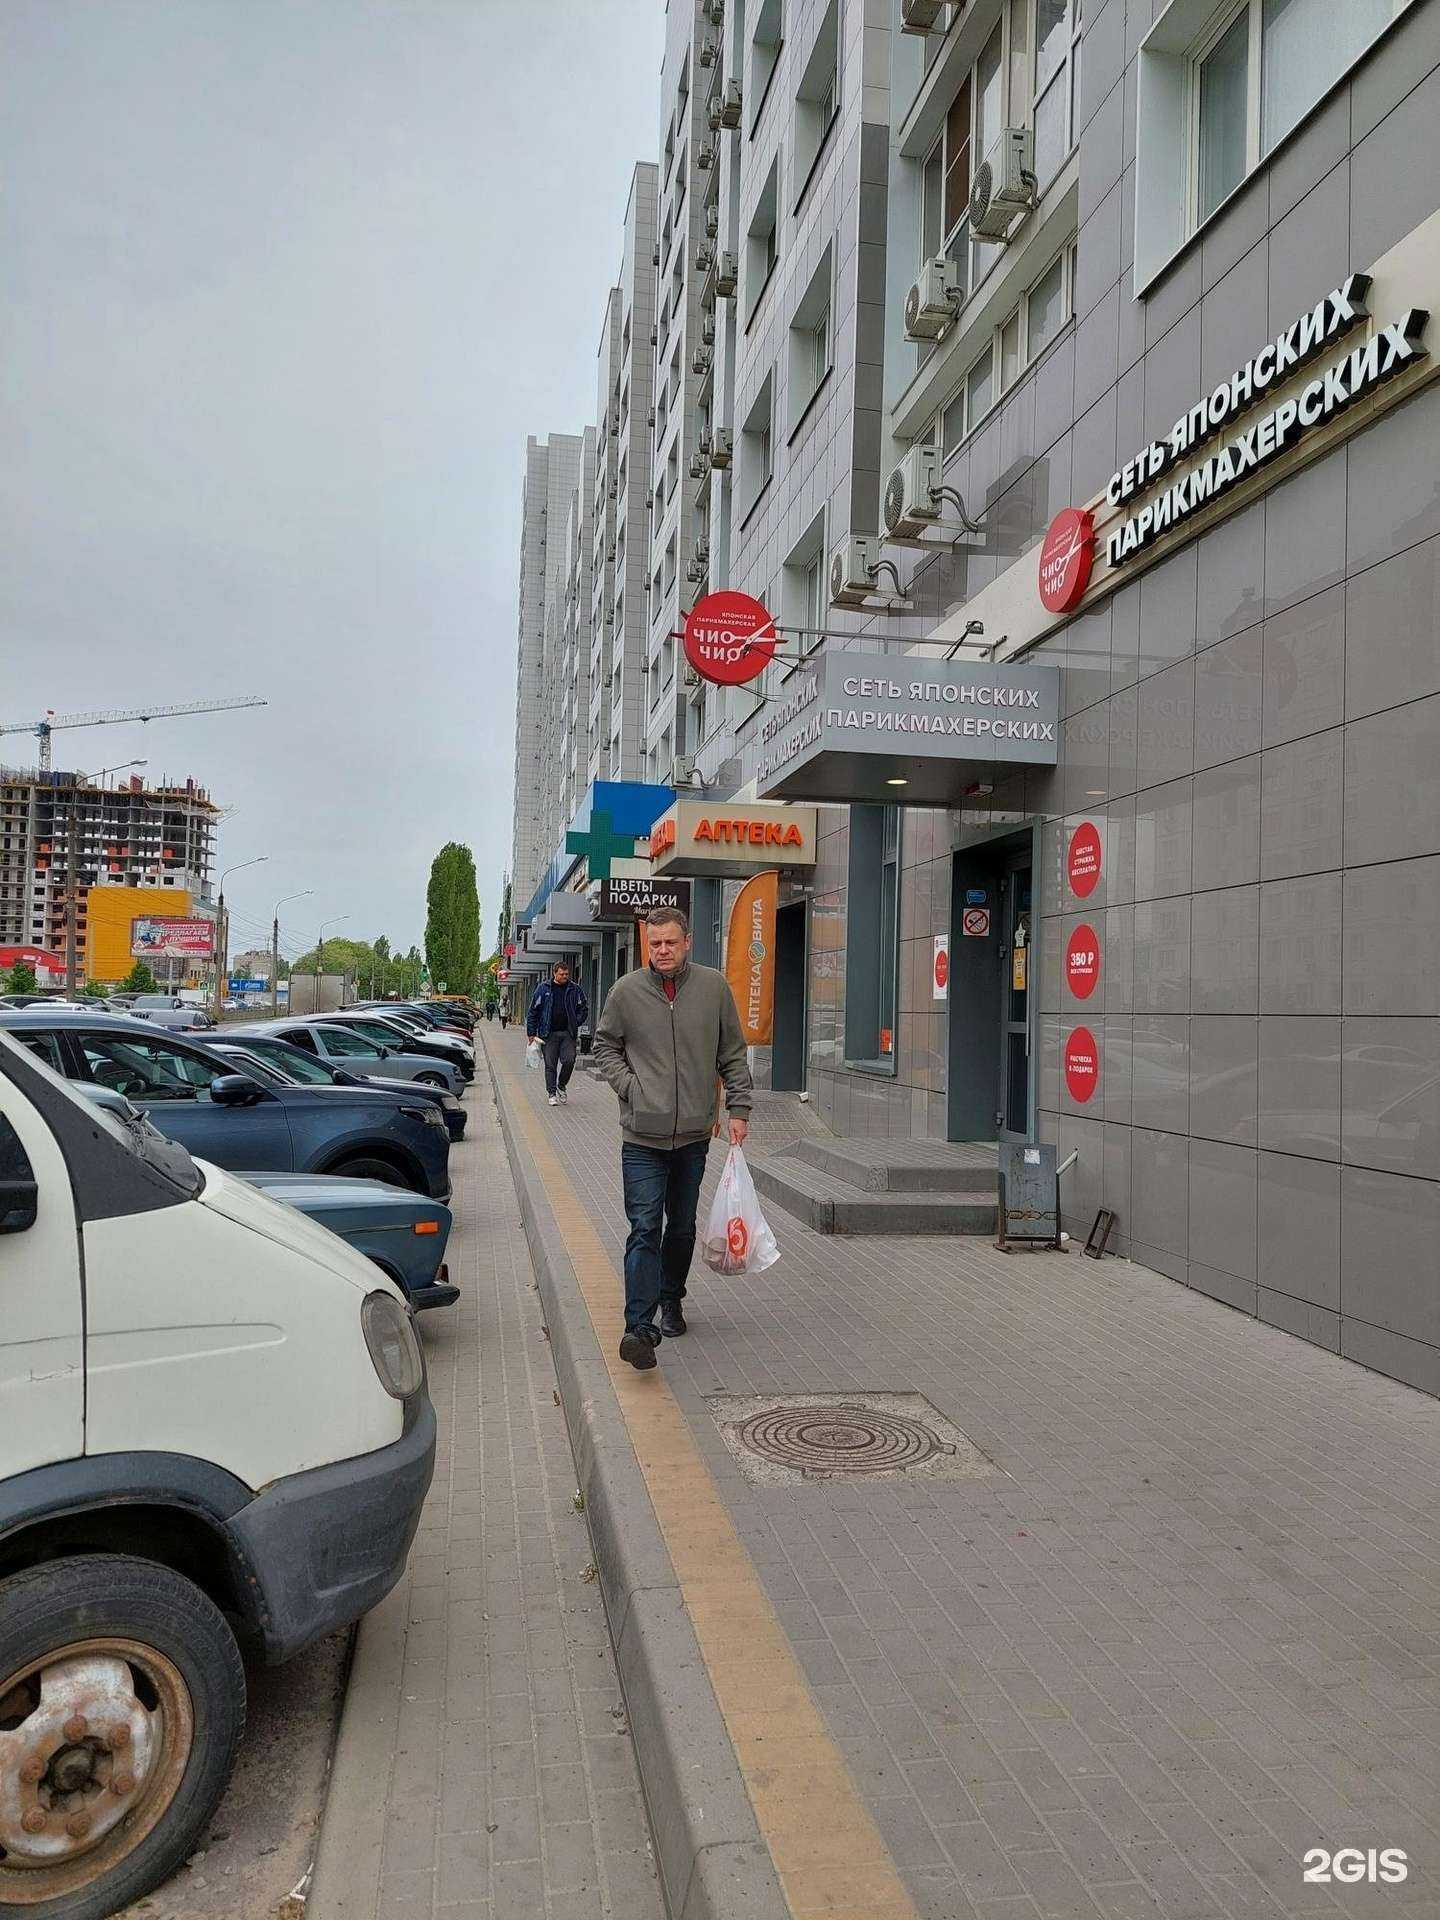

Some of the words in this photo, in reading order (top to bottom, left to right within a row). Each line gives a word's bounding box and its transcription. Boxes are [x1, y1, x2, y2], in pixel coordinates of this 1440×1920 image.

[1106, 441, 1170, 507] СЕТЬ
[1170, 274, 1371, 455] ЯПОНСКИХ
[1106, 309, 1427, 567] ПАРИКМАХЕРСКИХ
[1042, 557, 1062, 580] ЧИО
[1045, 572, 1064, 596] ЧИО
[696, 617, 757, 627] ПАРИКМАХЕРСКАЯ
[721, 612, 756, 620] ЯПОНСКАЯ
[693, 628, 736, 644] ЧИО
[699, 645, 741, 664] ЧИО
[843, 677, 902, 699] СЕТЬ
[909, 682, 1039, 709] ЯПОНСКИХ
[826, 709, 1054, 741] ПАРИКМАХЕРСКИХ
[693, 818, 803, 846] АПТЕКА
[610, 879, 653, 893] ЦВЕТЫ
[609, 892, 678, 907] ПОДАРКИ
[752, 898, 762, 941] ВИТА
[748, 963, 761, 1030] АПТЕКА
